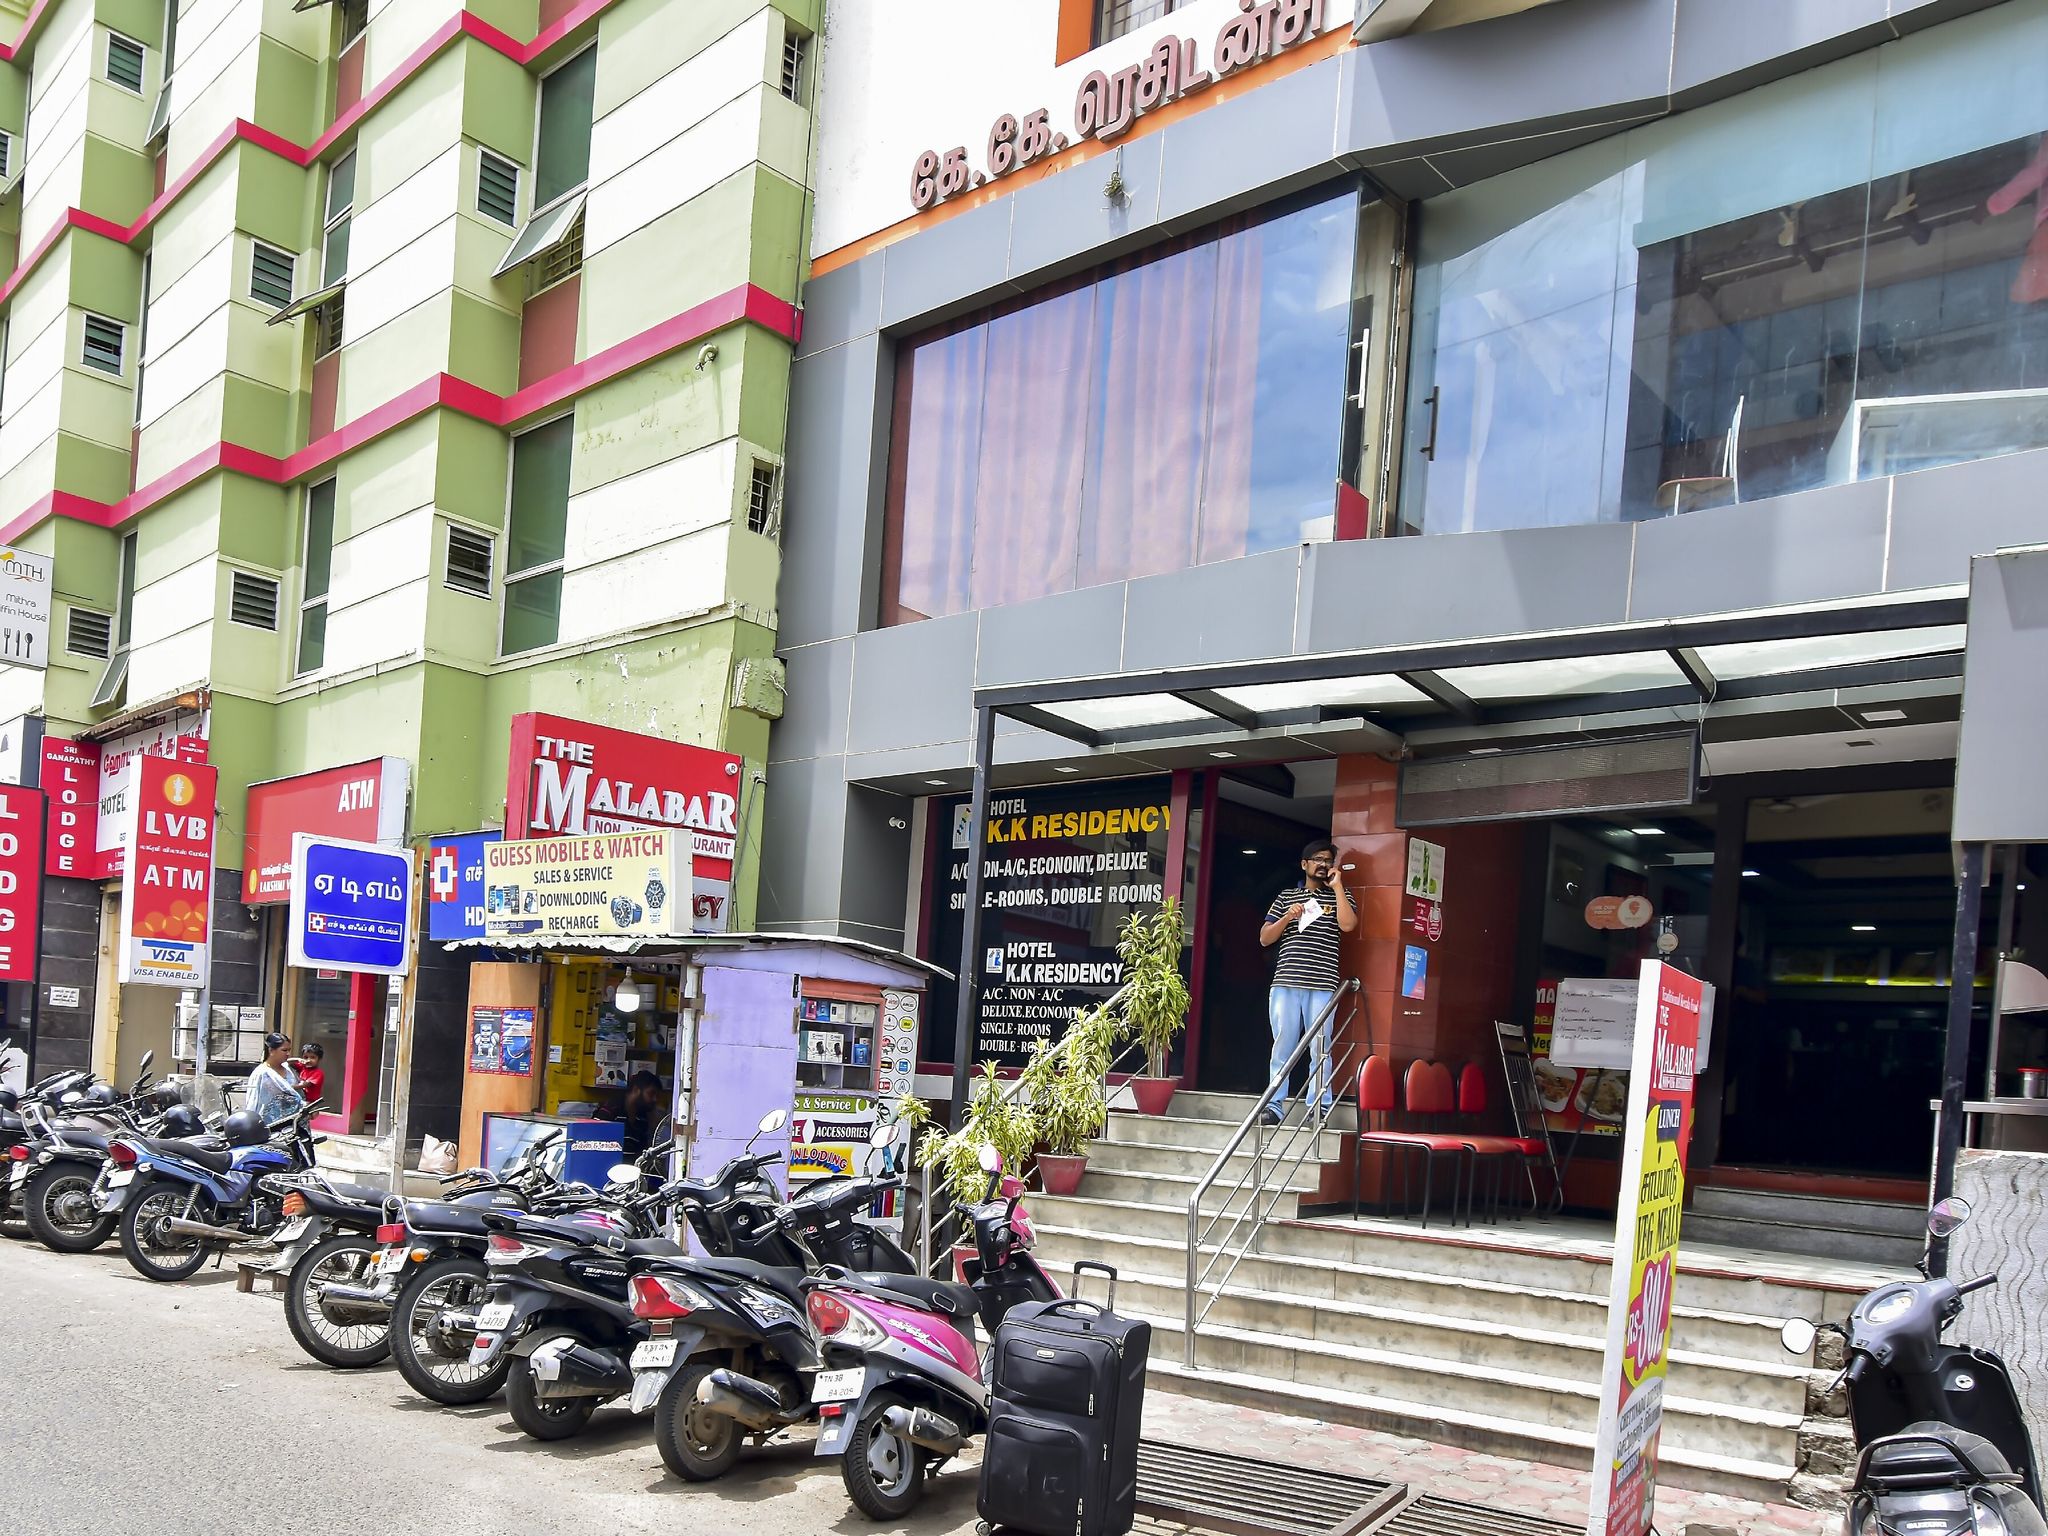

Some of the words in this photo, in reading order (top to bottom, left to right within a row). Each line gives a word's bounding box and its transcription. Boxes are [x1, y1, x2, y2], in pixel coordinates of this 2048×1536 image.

[5, 560, 43, 580] MTH
[17, 609, 47, 623] House
[46, 752, 96, 766] GANAPATHY
[64, 746, 78, 754] SRI
[536, 735, 595, 765] THE
[100, 793, 126, 816] HOTEL
[338, 778, 375, 813] ATM
[530, 758, 738, 835] MALABAR
[990, 798, 1027, 816] HOTEL
[145, 810, 207, 840] LVB
[594, 819, 621, 834] NON
[987, 816, 1027, 844] K.K
[1031, 805, 1171, 840] RESIDENCY
[490, 845, 532, 867] GUESS
[535, 840, 590, 864] MOBILE
[593, 840, 605, 858] &
[608, 834, 663, 858] WATCH
[691, 836, 731, 855] URANT
[1096, 851, 1149, 871] DELUXE
[142, 864, 204, 891] ATM
[533, 869, 562, 885] SALES
[563, 869, 572, 882] &
[573, 866, 613, 882] SERVICE
[341, 877, 363, 903] டி
[365, 877, 403, 901] எம்
[540, 890, 608, 908] DOWNLODING
[1051, 886, 1103, 905] DOUBLE
[1108, 883, 1162, 903] ROOMS
[548, 915, 599, 931] RECHARGE
[151, 949, 186, 963] VISA
[1007, 942, 1056, 959] HOTEL
[133, 967, 154, 977] VISA
[156, 970, 200, 981] ENABLED
[1005, 963, 1032, 984] K.K
[1034, 962, 1124, 984] RESIDENCY
[1653, 1027, 1695, 1088] MALABAR
[803, 1097, 812, 1109] &
[814, 1097, 851, 1111] Service
[1658, 1108, 1681, 1129] LUNCH
[815, 1124, 869, 1139] ACCESSORIES
[1636, 1211, 1655, 1264] VEG
[1656, 1202, 1681, 1253] MEALS
